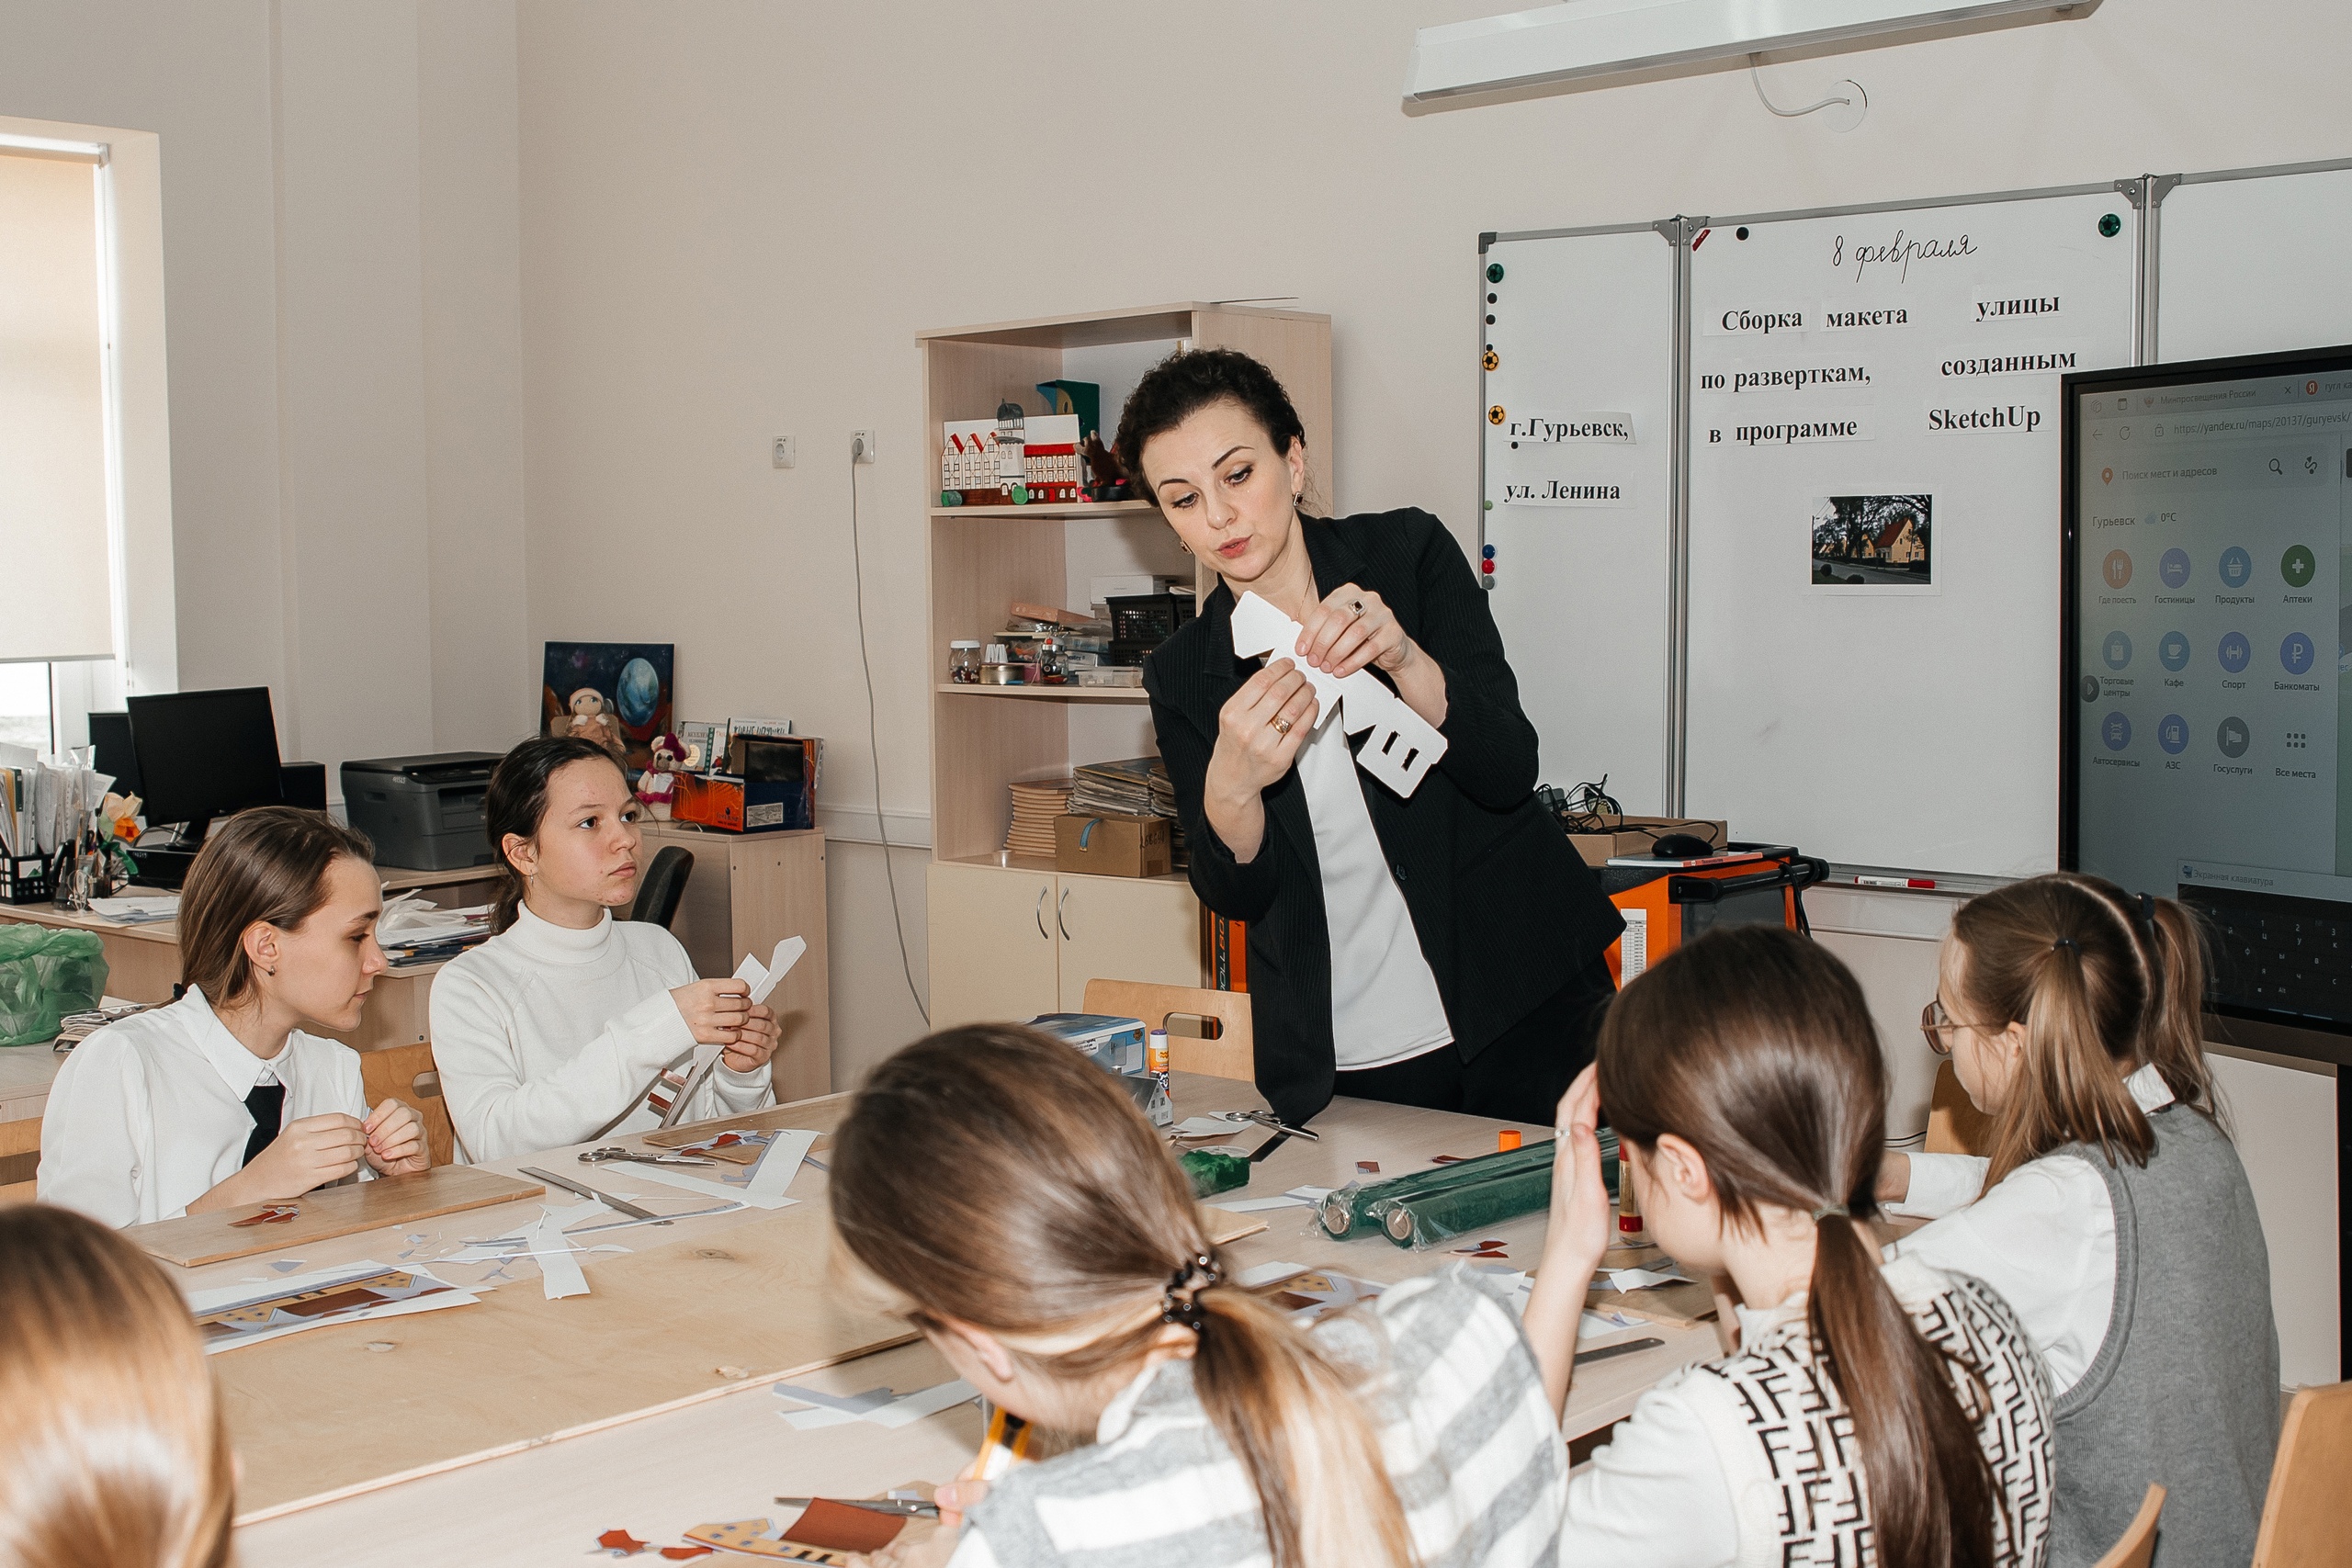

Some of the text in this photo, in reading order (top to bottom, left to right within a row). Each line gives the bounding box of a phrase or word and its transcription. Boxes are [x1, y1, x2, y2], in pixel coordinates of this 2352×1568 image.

[1832, 229, 1979, 285] 8 февраля
[1721, 296, 2061, 335] Сборка макета улицы
[1700, 351, 2077, 394] по разверткам, созданным
[2229, 389, 2257, 399] России
[1509, 417, 1630, 443] г.Гурьевск,
[1708, 404, 2042, 446] в программе SketchUp
[2121, 467, 2218, 480] Поиск мест и адресов
[1503, 479, 1622, 503] ул. Ленина
[2092, 515, 2136, 529] Гурьевск
[2098, 595, 2137, 605] Где поесть
[2154, 595, 2196, 606] Гостиницы
[2214, 594, 2256, 605] Продукты
[2282, 594, 2313, 604] Аптеки
[2100, 675, 2134, 686] Торговые
[2164, 677, 2185, 689] Кафе
[2222, 680, 2247, 691] Спорт
[2274, 681, 2321, 693] Банкоматы
[2103, 690, 2131, 699] центры
[2092, 756, 2141, 769] Автосервисы
[2165, 760, 2182, 770] АЗС
[2213, 763, 2254, 776] Госуслуги
[2275, 767, 2317, 779] Все места
[2193, 868, 2275, 888] Экранная клавиатура
